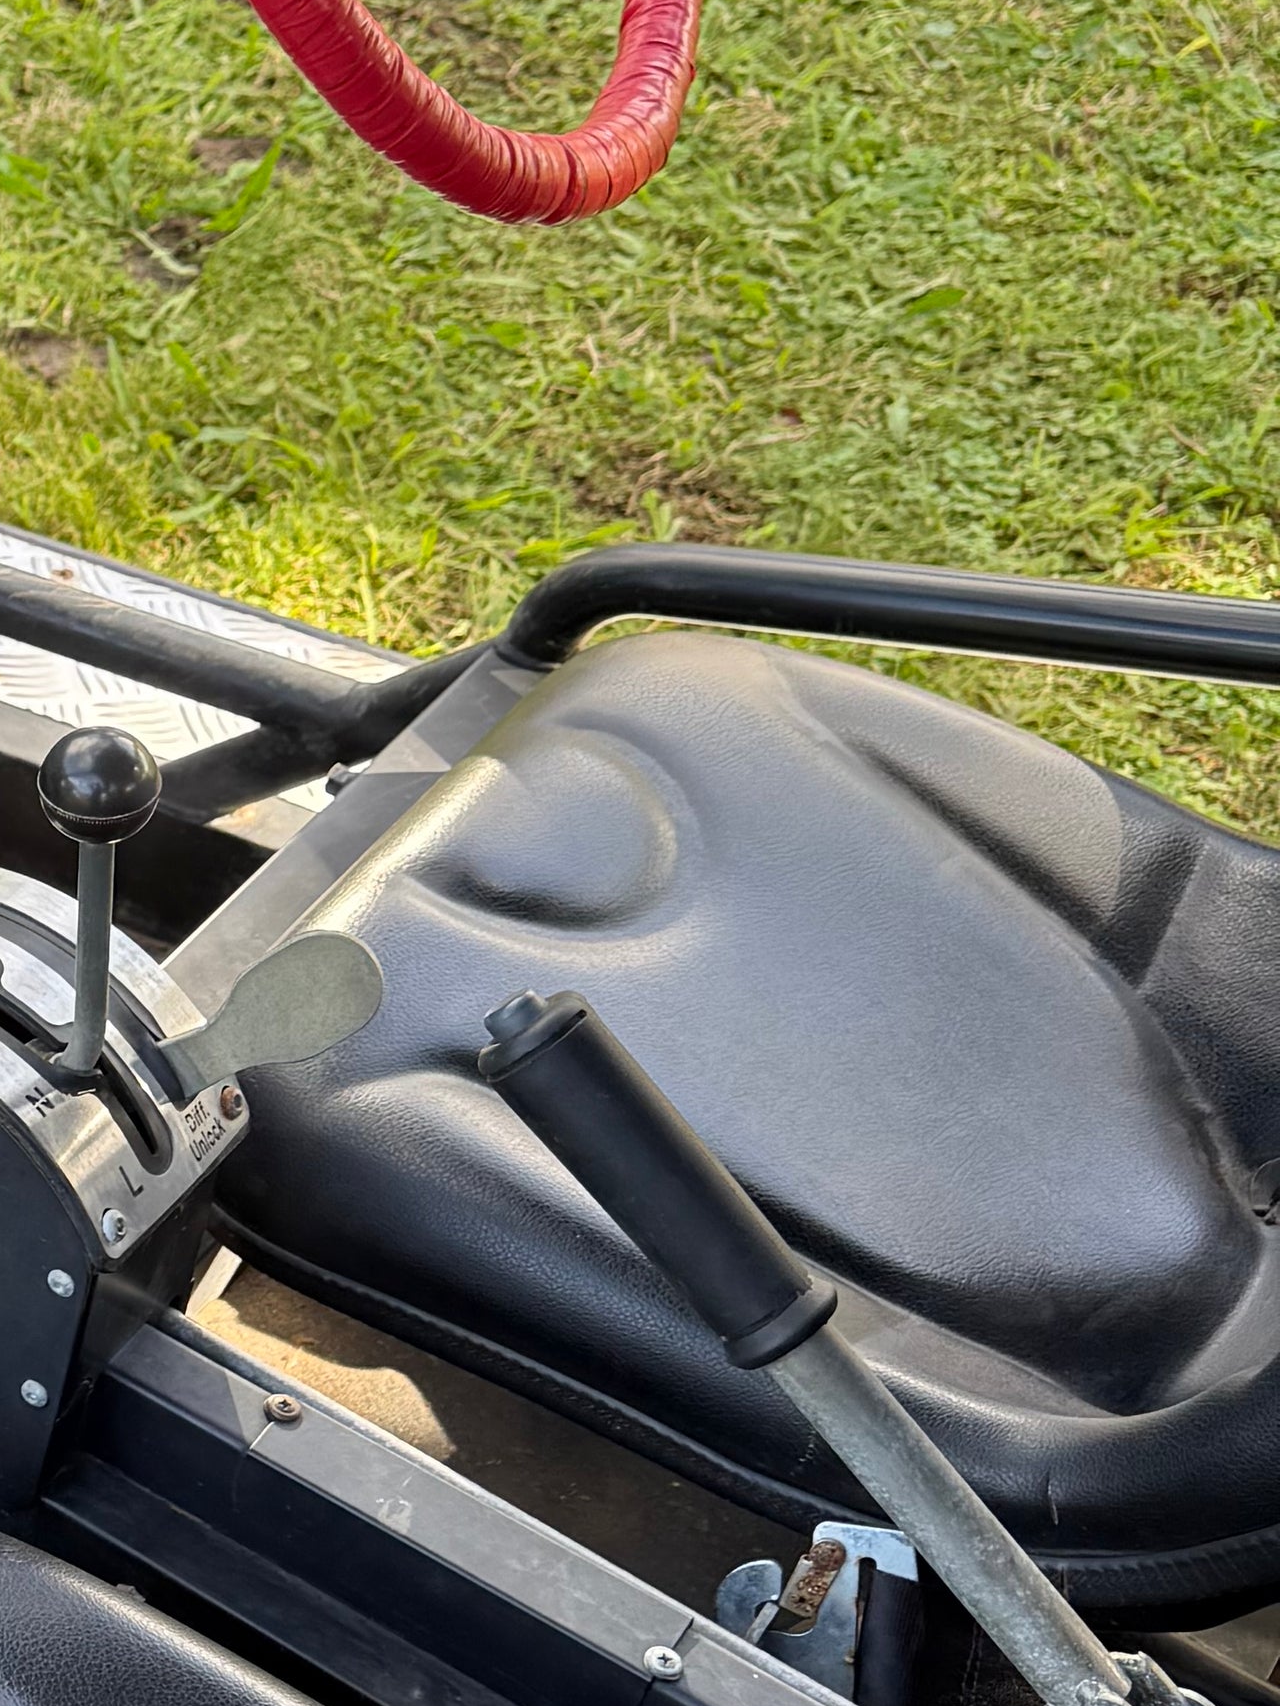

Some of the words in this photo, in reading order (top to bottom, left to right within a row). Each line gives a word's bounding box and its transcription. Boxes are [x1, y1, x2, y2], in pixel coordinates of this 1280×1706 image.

[25, 1086, 55, 1118] N
[185, 1101, 210, 1132] Diff.
[189, 1117, 226, 1161] Unlock
[119, 1165, 144, 1197] L
